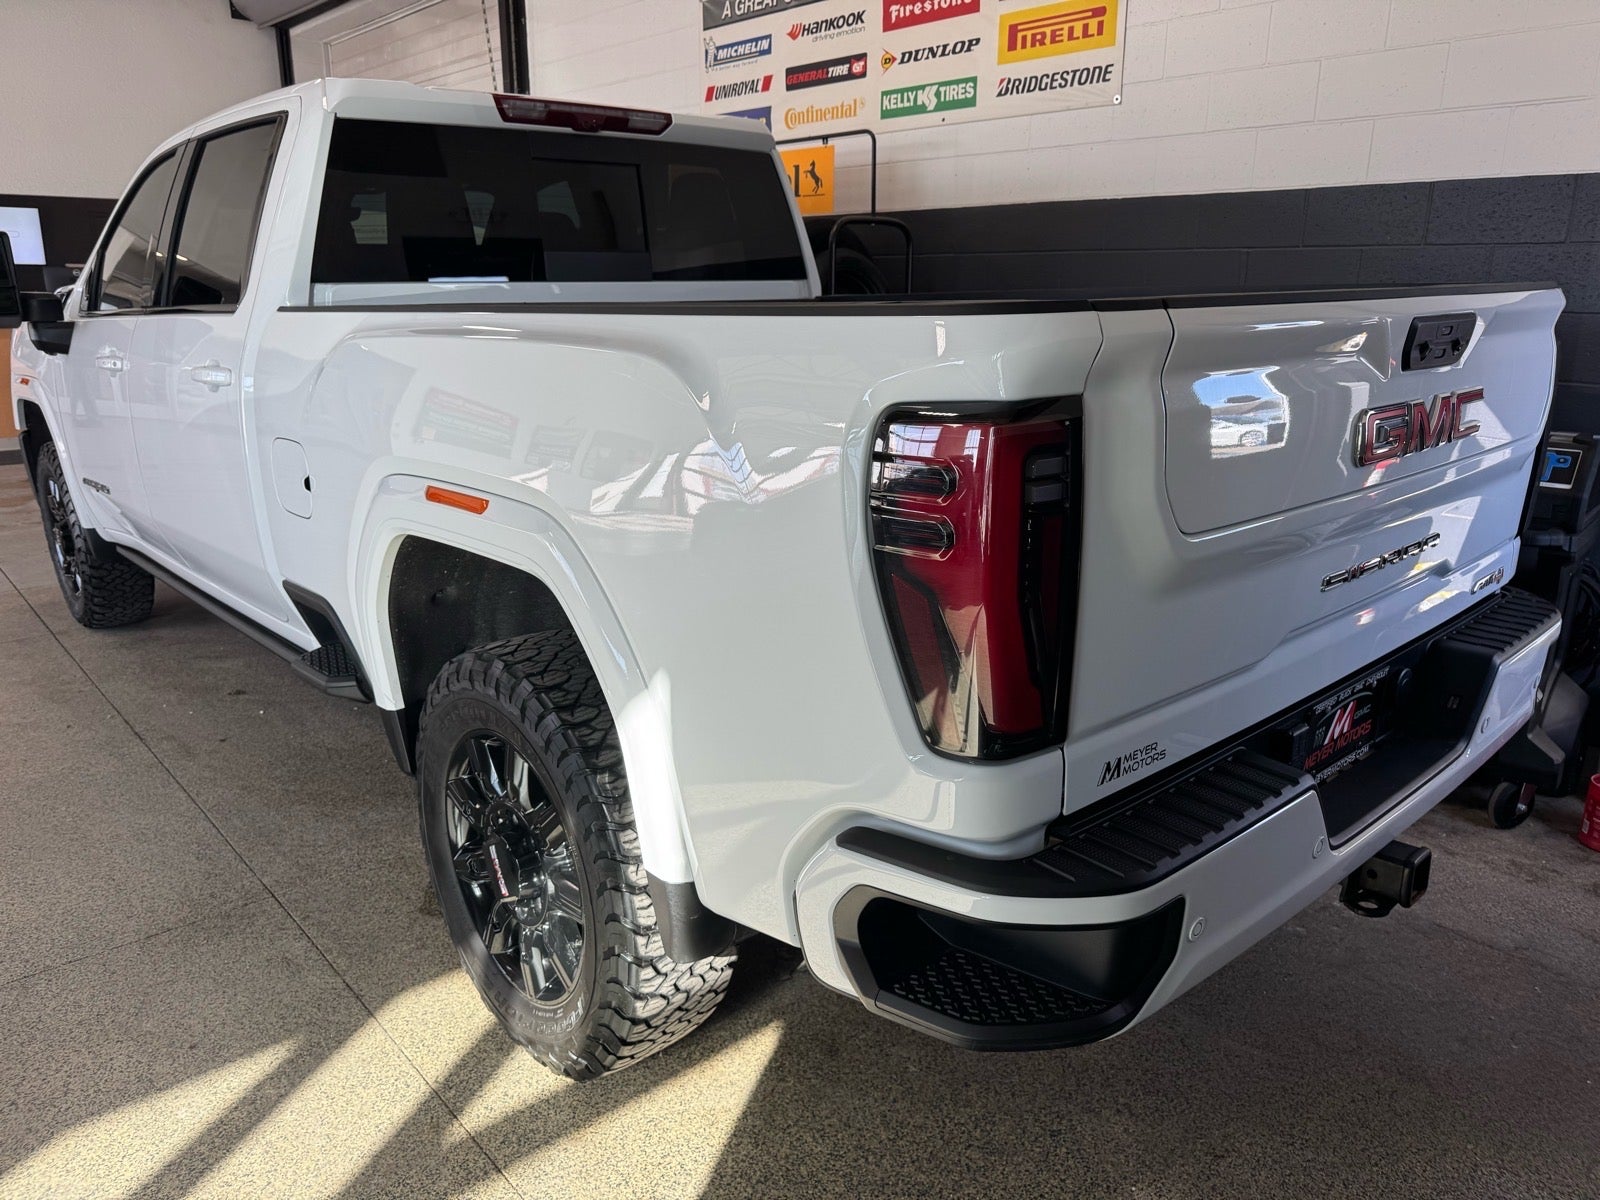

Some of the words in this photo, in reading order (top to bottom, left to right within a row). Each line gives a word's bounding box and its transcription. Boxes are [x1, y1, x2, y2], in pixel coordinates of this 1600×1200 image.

[721, 0, 731, 19] A
[889, 0, 972, 24] Firesto
[836, 26, 866, 37] emotion
[1007, 6, 1107, 52] PIRELLI
[717, 38, 770, 60] MICHELIN
[898, 37, 981, 65] DUNLOP
[714, 78, 760, 100] UNIROYAL
[996, 64, 1114, 98] BRIDGESTONE
[882, 90, 916, 110] KELLY
[939, 82, 974, 102] TIRES
[784, 98, 858, 130] Continental
[1354, 386, 1484, 468] GMC
[1335, 720, 1372, 751] MOTORS
[1122, 749, 1166, 776] MOTORS
[1123, 742, 1158, 765] MEYER
